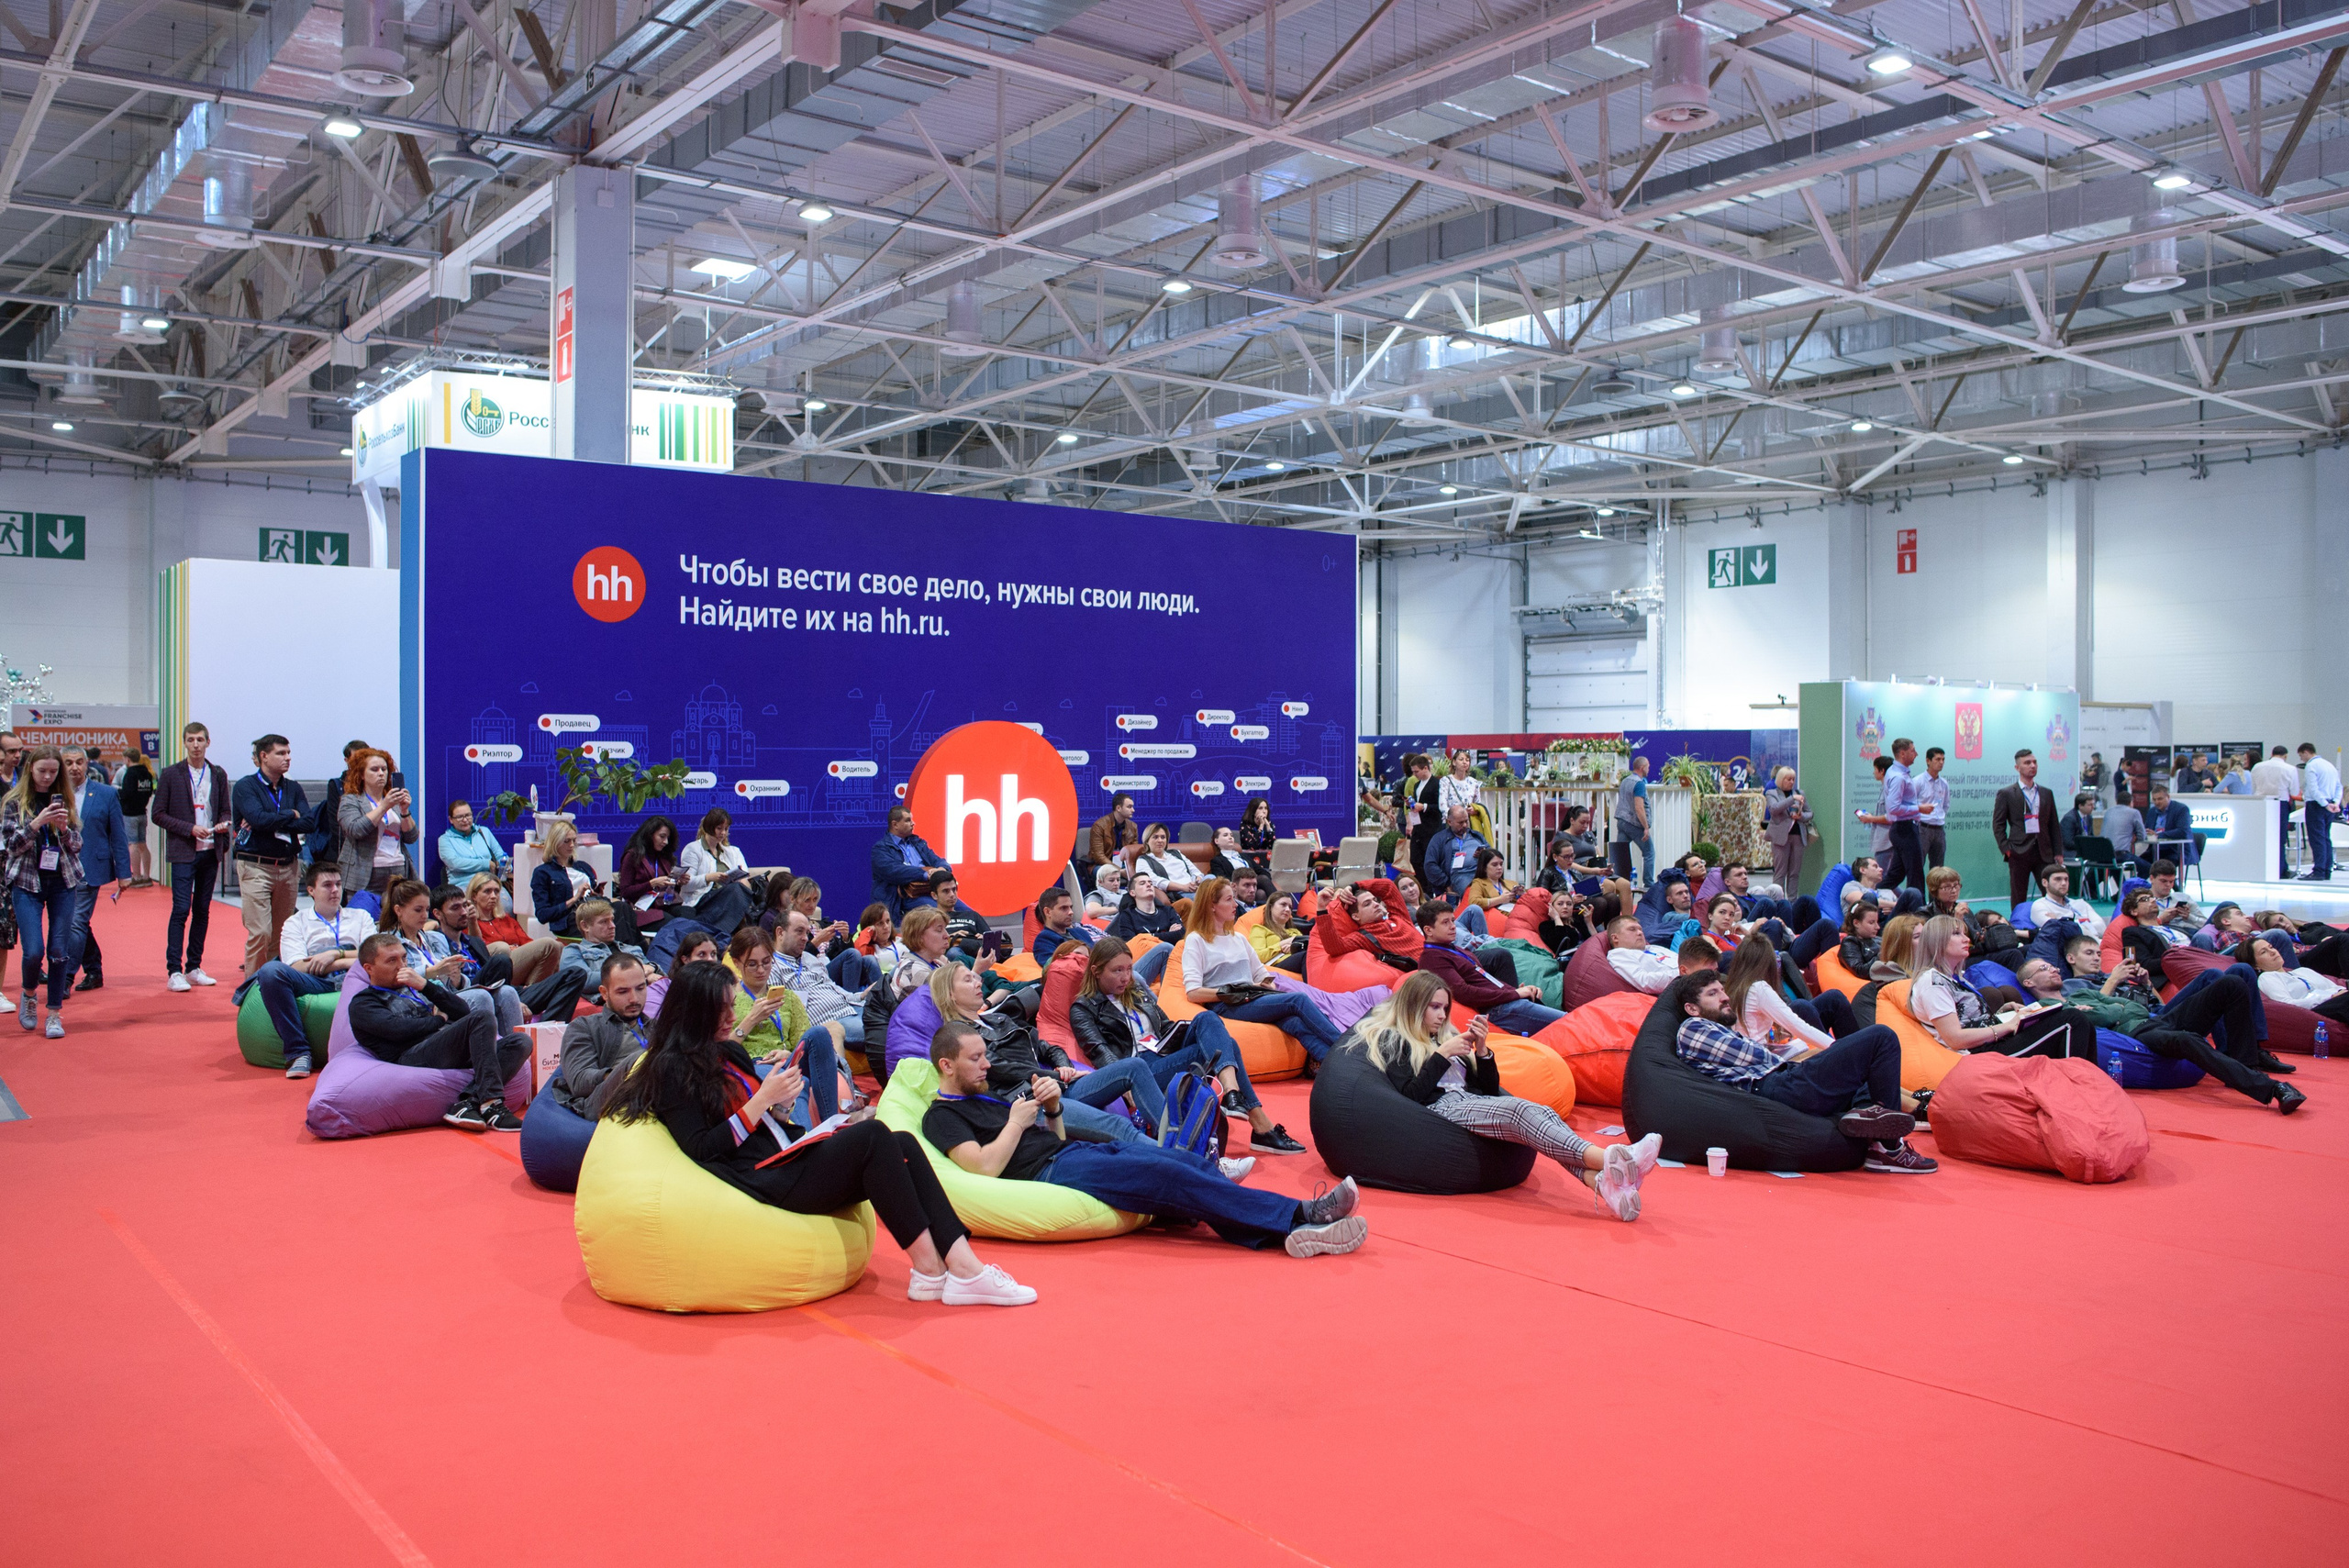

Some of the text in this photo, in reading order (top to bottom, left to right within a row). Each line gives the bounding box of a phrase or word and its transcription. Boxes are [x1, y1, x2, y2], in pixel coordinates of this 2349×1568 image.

[585, 62, 595, 92] 15
[1322, 554, 1338, 571] 0+
[586, 563, 633, 602] hh
[680, 553, 1200, 617] Чтобы вести свое дело, нужны свои люди.
[680, 595, 950, 637] Найдите их на hh.ru.
[1207, 713, 1230, 721] Директор
[554, 718, 592, 728] Продавец
[1128, 718, 1152, 727] Дизайнер
[1241, 728, 1264, 737] Бухгалтер
[20, 731, 128, 745] ЧЕМПИОНИКА
[482, 749, 513, 760] Риэлтор
[841, 764, 871, 773] Водитель
[1300, 780, 1323, 788] Официант
[1966, 774, 1979, 784] ПРИ
[750, 784, 782, 794] Охранник
[1949, 789, 1997, 800] РАВ ПРЕДПРИН
[945, 773, 1050, 864] hh
[542, 1058, 559, 1066] бизн
